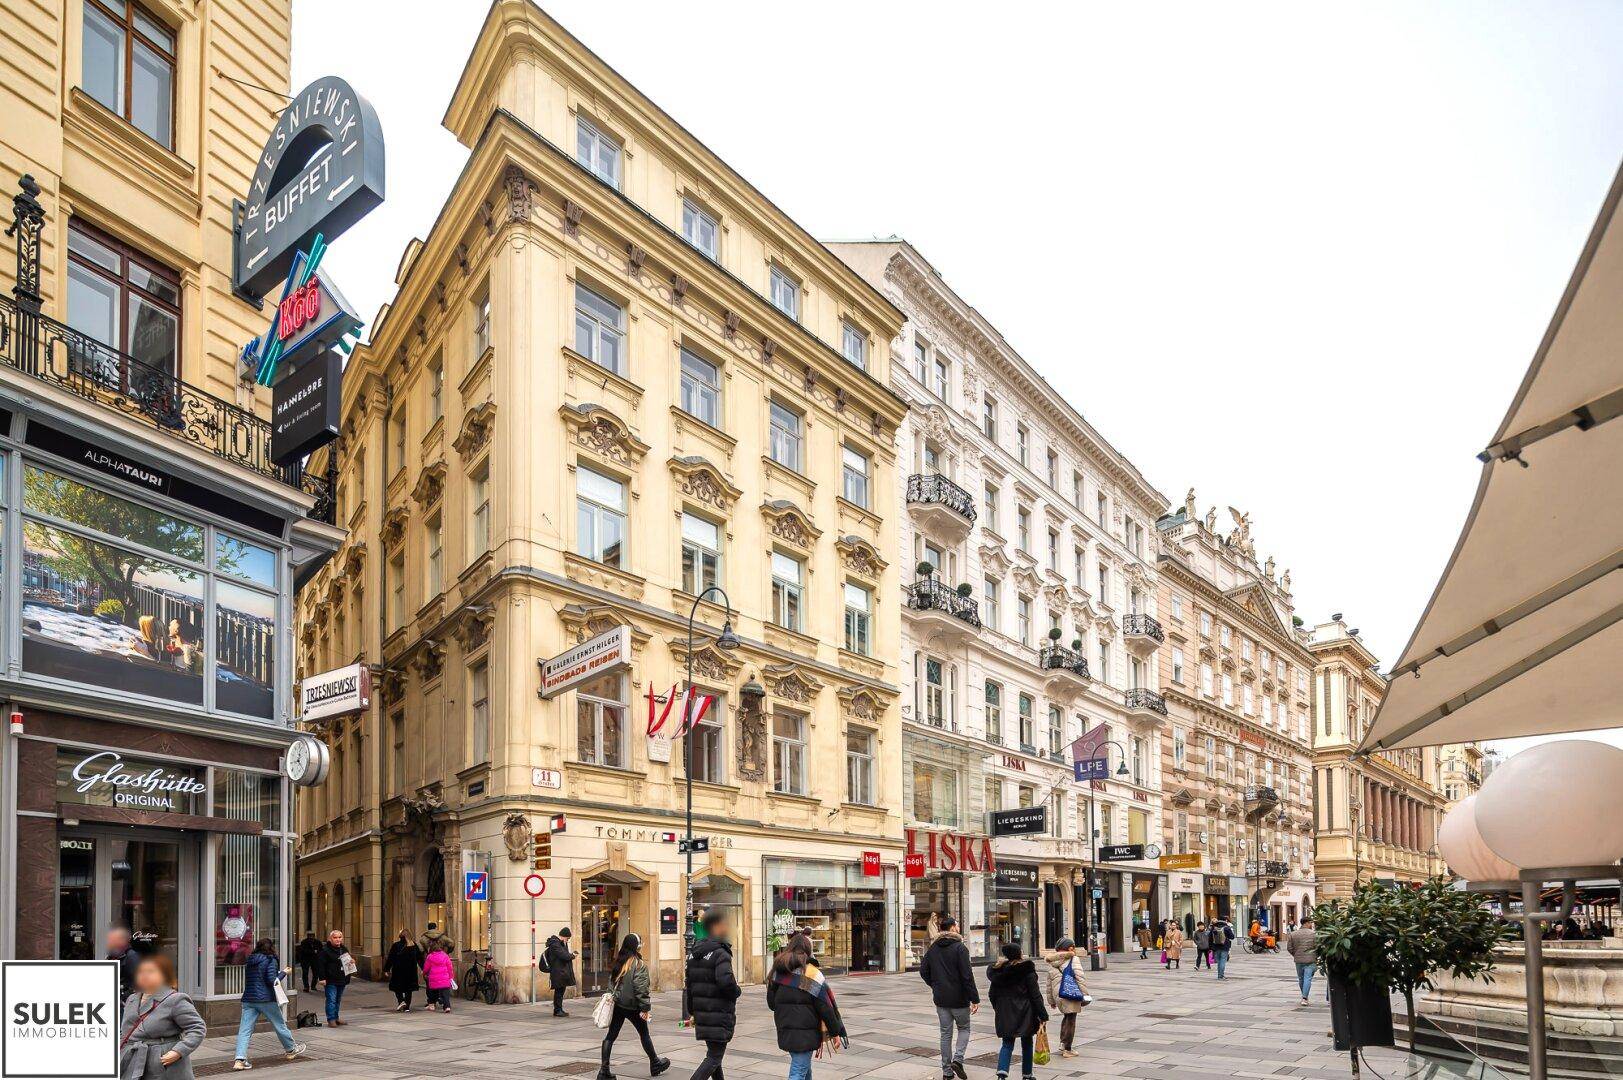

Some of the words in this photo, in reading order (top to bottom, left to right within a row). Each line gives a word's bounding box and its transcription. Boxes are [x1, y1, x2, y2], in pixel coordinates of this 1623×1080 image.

[245, 87, 358, 245] TRZESNIEWSKI
[265, 154, 333, 234] BUFFET
[277, 377, 323, 415] HANNELORE
[84, 450, 162, 487] ALPHATAURI
[552, 655, 576, 671] GALERIE
[576, 646, 596, 660] ERNST
[596, 634, 620, 650] HILGER
[546, 665, 587, 688] SINDBADS
[588, 649, 620, 671] REISEN
[1002, 755, 1026, 772] LISKA
[72, 752, 207, 794] Glashütte
[541, 770, 552, 782] 11
[115, 793, 176, 809] ORIGINAL
[997, 814, 1043, 825] LIEBESKIND
[595, 826, 658, 842] TOMMY
[1114, 847, 1131, 855] IWC
[865, 855, 880, 865] högl
[906, 857, 923, 866] högl
